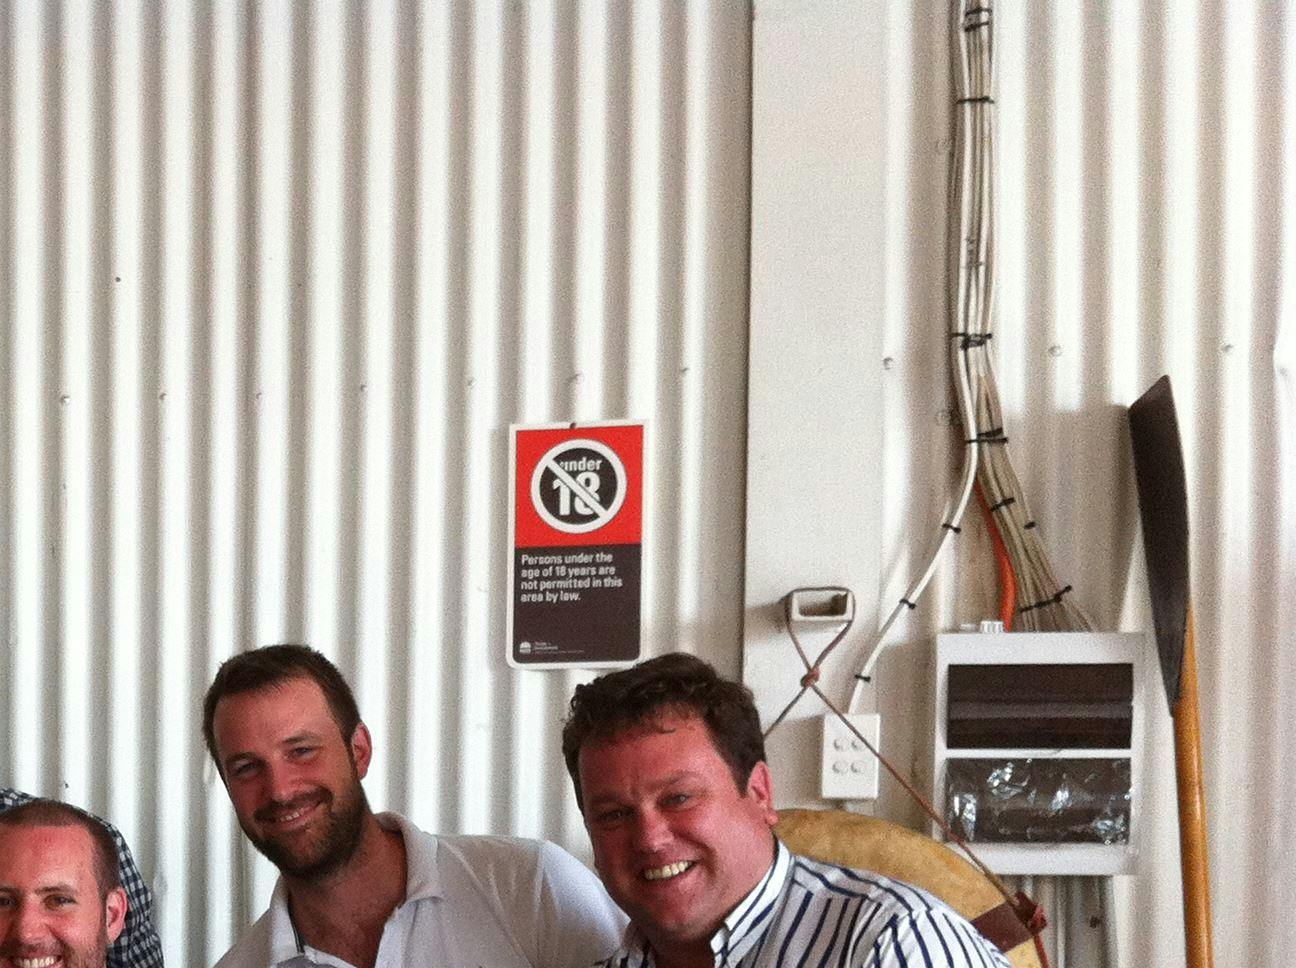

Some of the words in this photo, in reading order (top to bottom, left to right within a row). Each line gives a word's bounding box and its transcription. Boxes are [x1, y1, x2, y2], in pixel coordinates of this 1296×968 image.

[558, 456, 602, 471] under
[552, 471, 601, 516] 18
[521, 554, 563, 566] Persons
[564, 552, 594, 564] under
[595, 551, 613, 563] the
[521, 568, 540, 579] age
[542, 566, 553, 577] of
[555, 565, 567, 577] 18
[568, 566, 597, 578] years
[598, 566, 616, 576] are
[520, 580, 538, 590] not
[540, 577, 591, 591] permitted
[592, 577, 602, 588] in
[604, 576, 623, 588] this
[520, 593, 544, 603] area
[545, 591, 558, 604] by
[560, 590, 581, 601] law.
